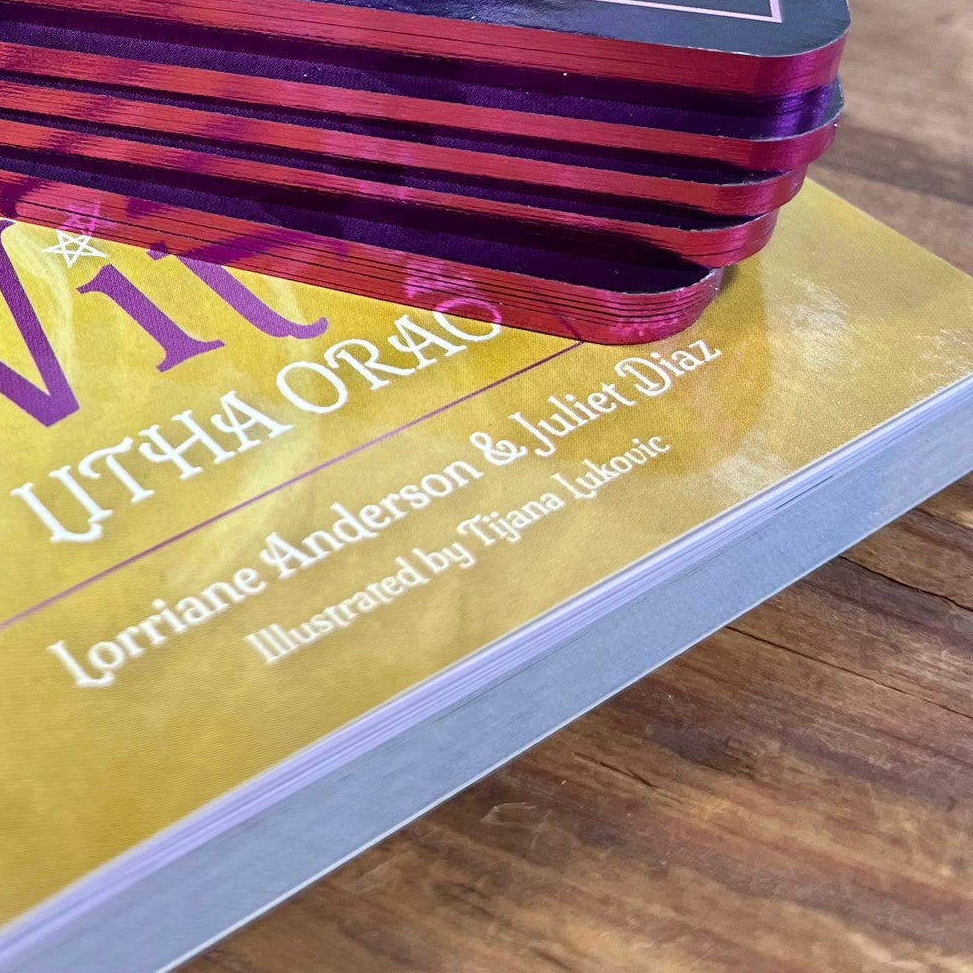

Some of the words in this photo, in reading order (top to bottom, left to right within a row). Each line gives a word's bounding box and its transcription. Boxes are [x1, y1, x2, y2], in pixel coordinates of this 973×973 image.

[10, 389, 294, 543] UTHA
[46, 567, 267, 688] Lorriane
[259, 460, 483, 579] Anderson
[469, 431, 527, 466] &
[508, 381, 636, 457] Juliet
[614, 339, 723, 397] Diaz
[243, 555, 430, 667] Illustrated
[411, 541, 476, 573] by
[456, 490, 565, 546] Tijana
[550, 435, 671, 500] Lukovic
